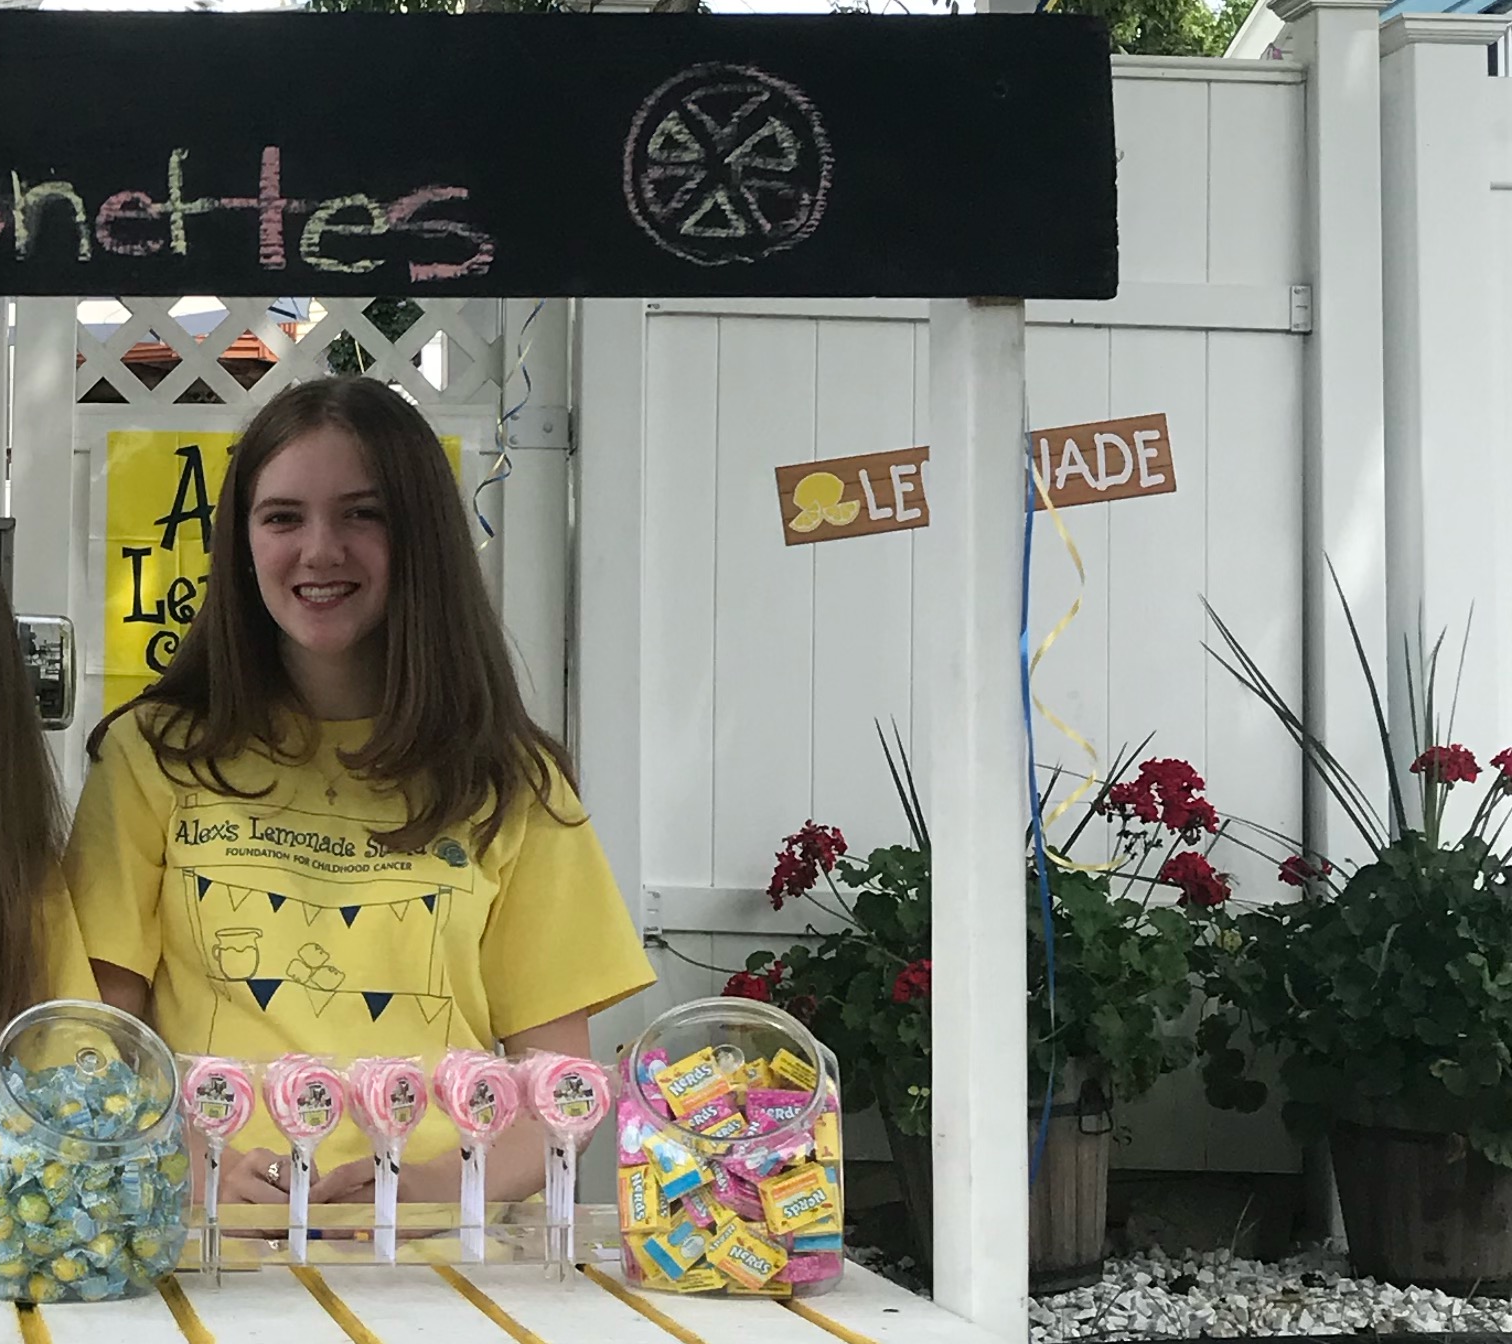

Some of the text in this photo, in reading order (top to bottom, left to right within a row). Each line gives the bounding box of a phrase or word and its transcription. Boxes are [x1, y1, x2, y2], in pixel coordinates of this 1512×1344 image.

[175, 819, 240, 845] Alex's
[248, 816, 356, 858] Lemonade
[226, 848, 413, 873] FOUNDATION FOR CHILDHOOD CANCER
